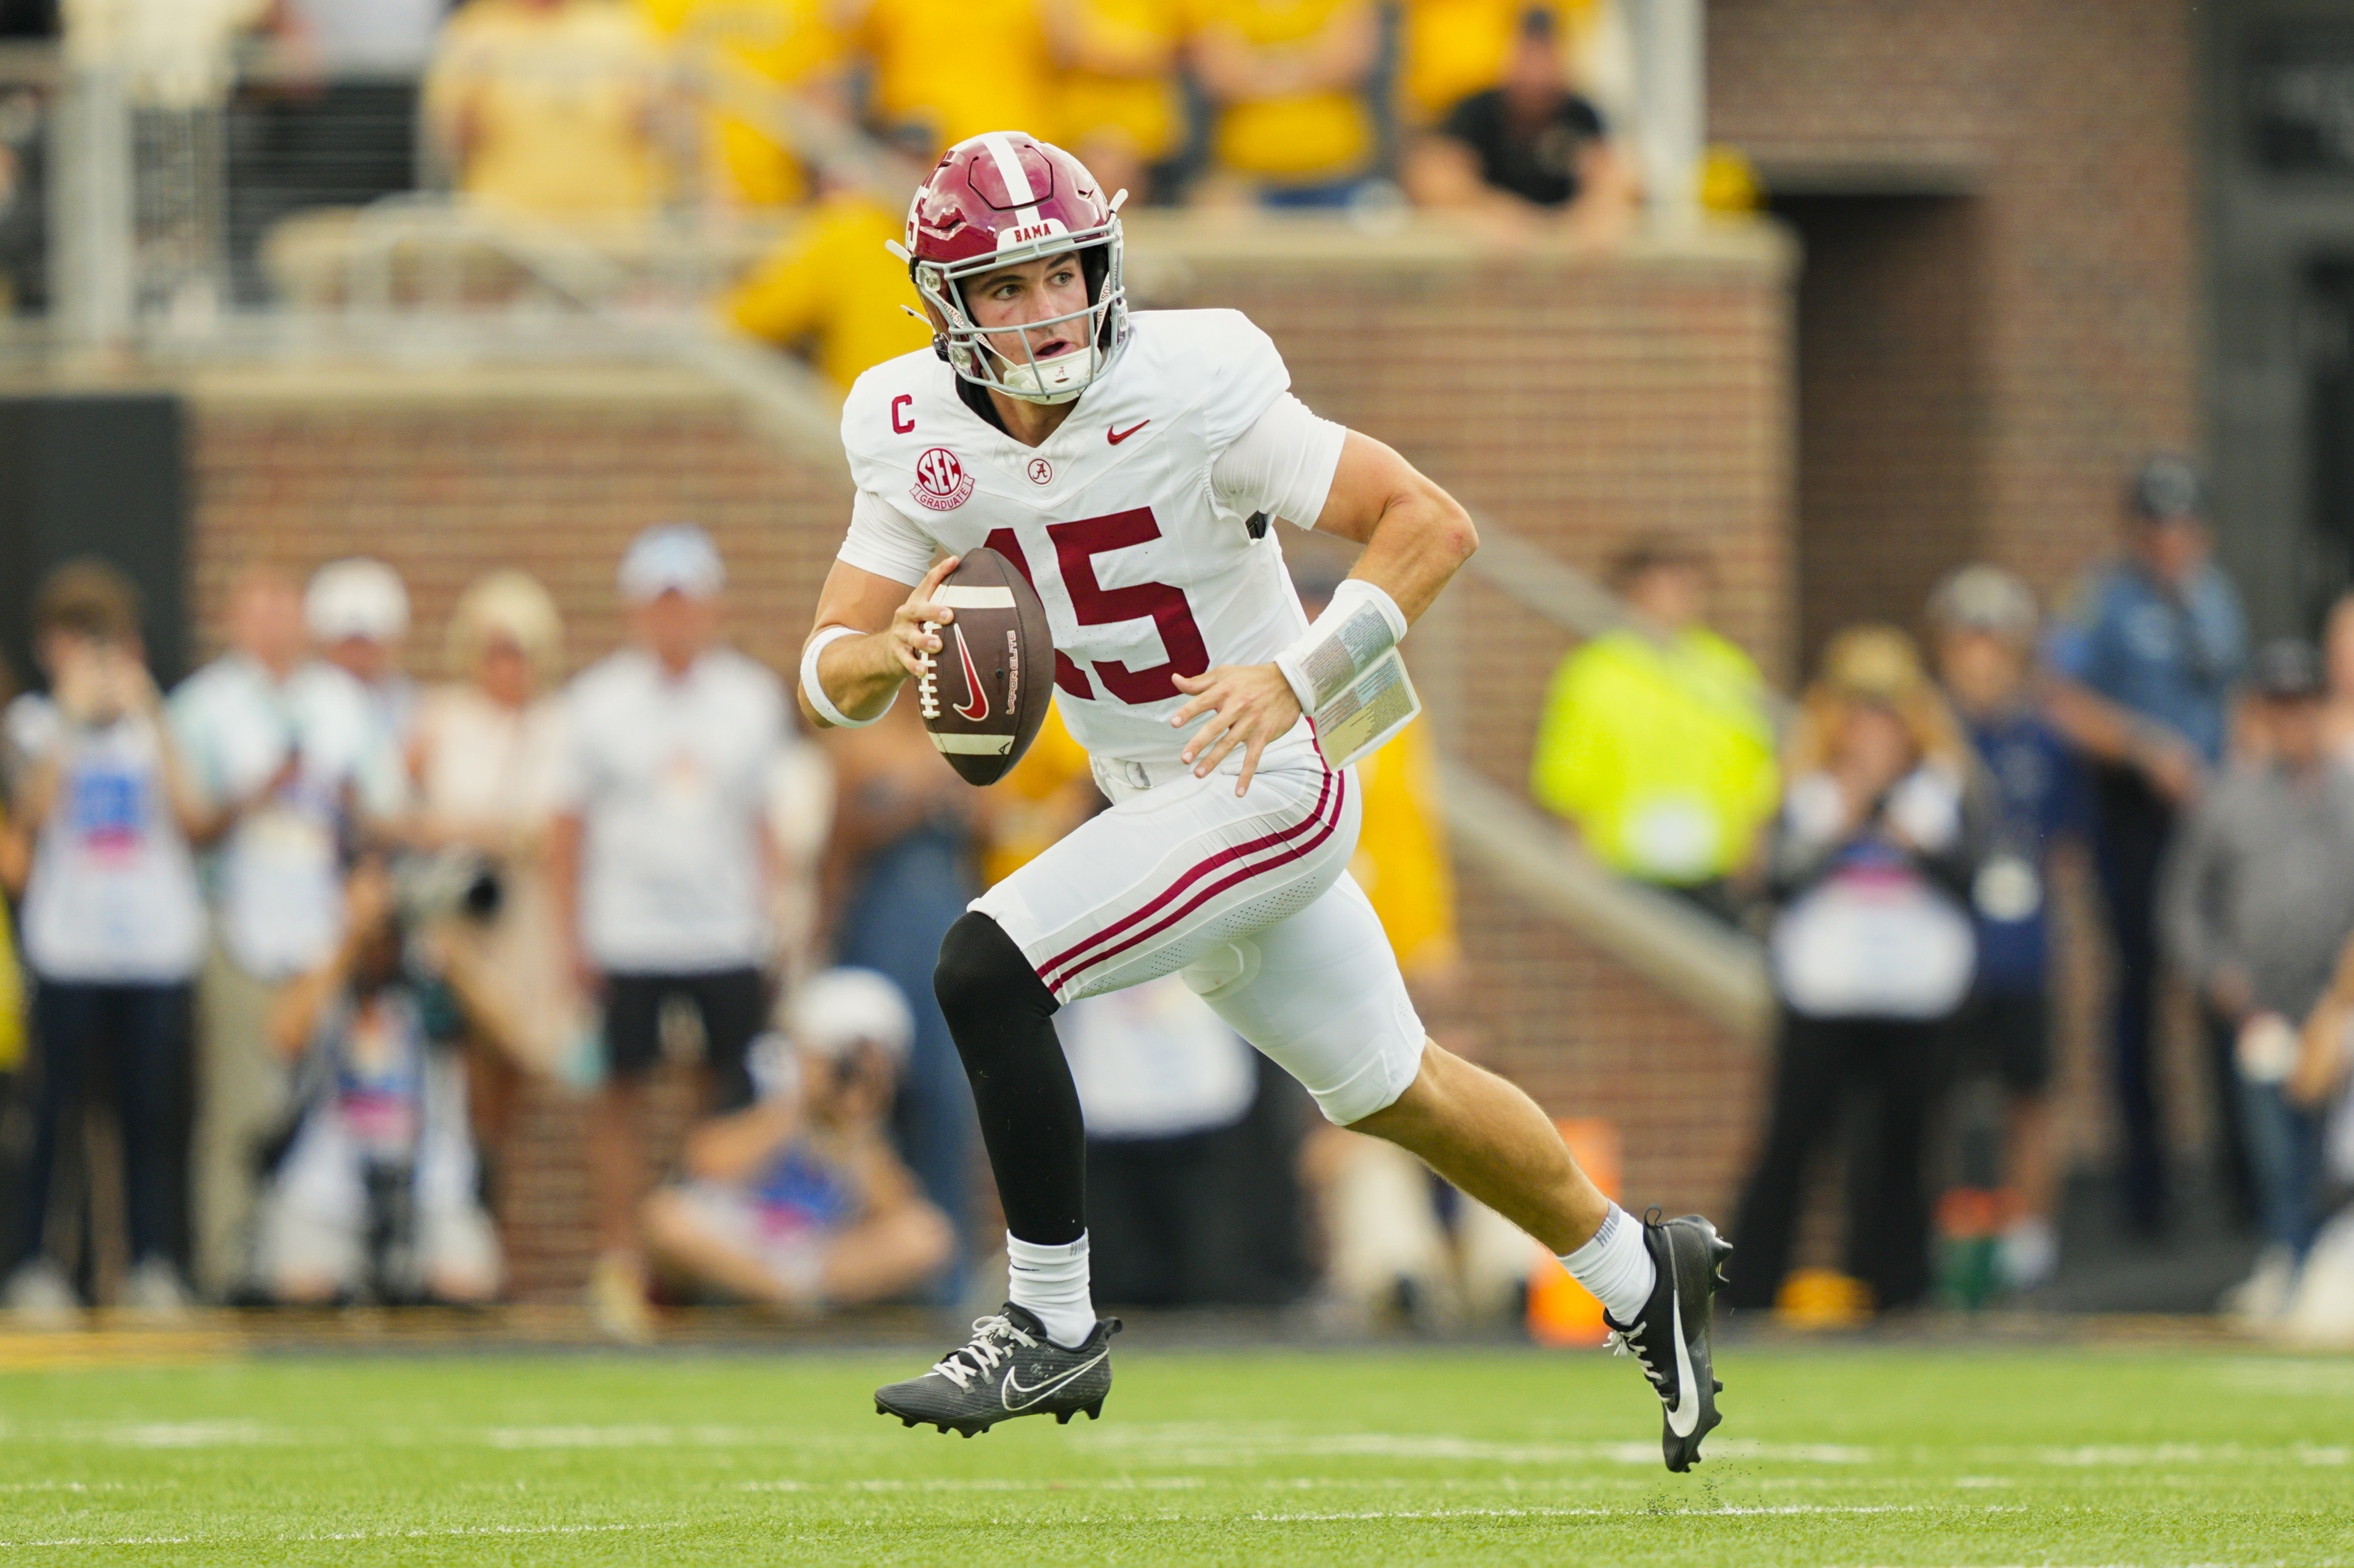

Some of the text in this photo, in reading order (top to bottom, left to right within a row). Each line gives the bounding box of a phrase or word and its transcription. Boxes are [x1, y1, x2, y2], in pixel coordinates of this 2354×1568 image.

[1014, 223, 1051, 242] BAMA
[939, 300, 966, 328] IMSO
[1098, 282, 1112, 323] CRSON
[1055, 366, 1066, 377] A
[891, 394, 915, 434] C
[918, 449, 960, 494] SEC
[1032, 462, 1048, 480] A
[920, 487, 968, 509] GRADUATE
[1006, 630, 1019, 714] VAPOR ELITE
